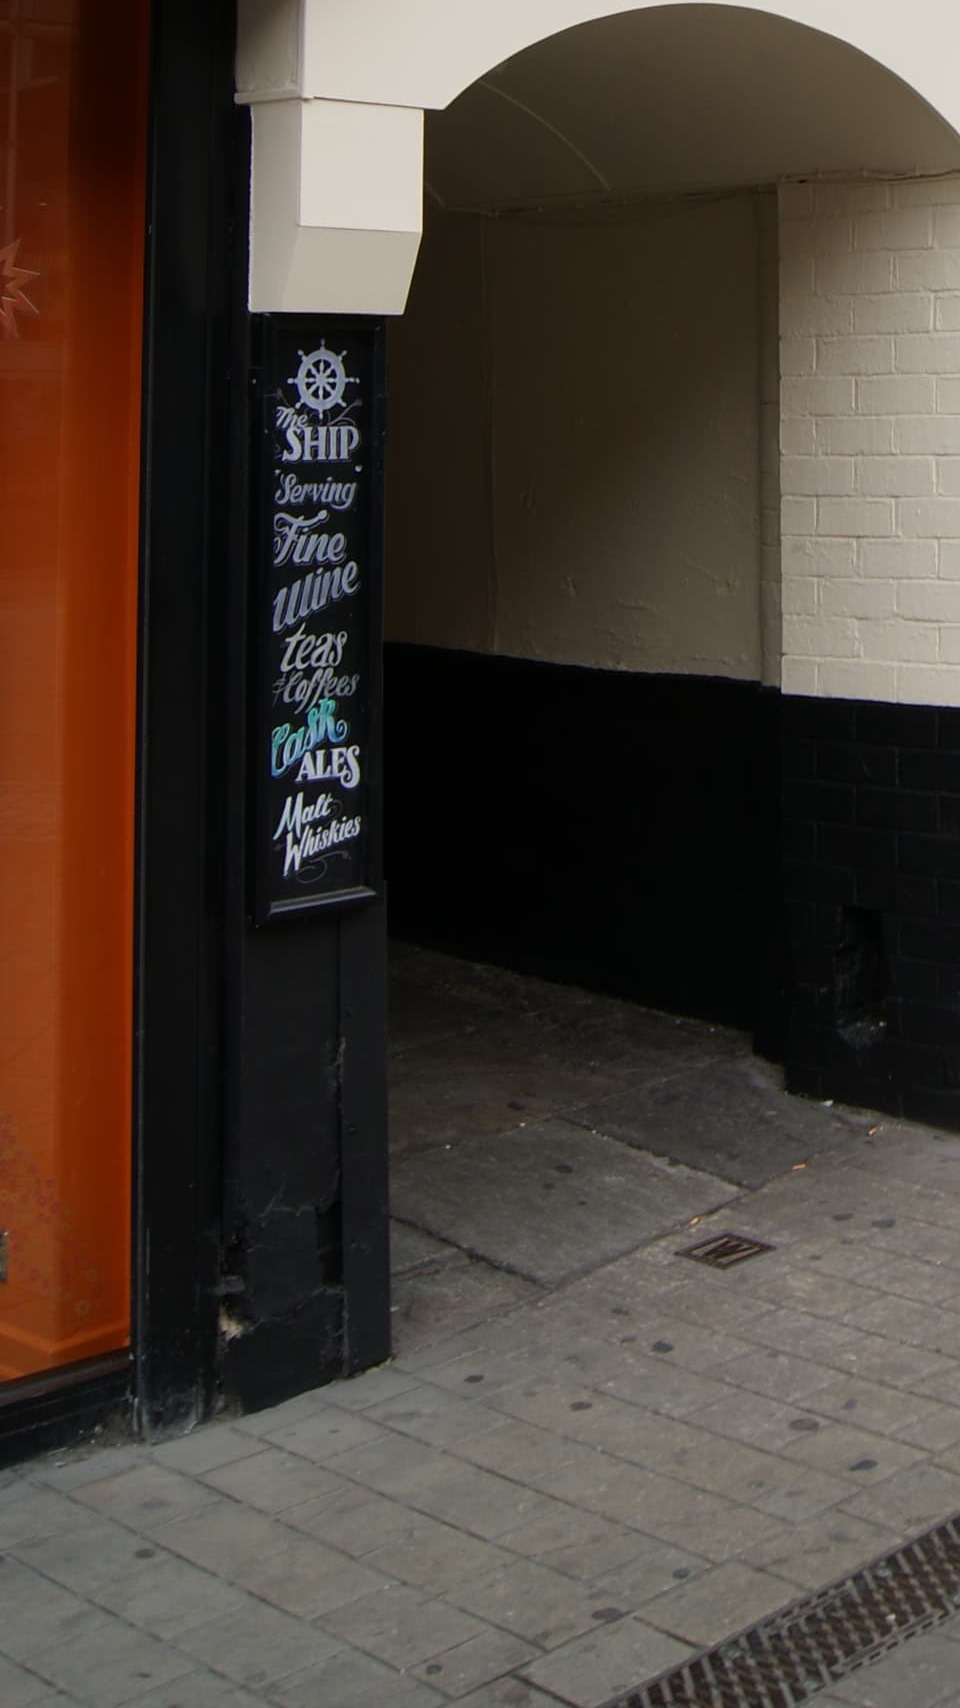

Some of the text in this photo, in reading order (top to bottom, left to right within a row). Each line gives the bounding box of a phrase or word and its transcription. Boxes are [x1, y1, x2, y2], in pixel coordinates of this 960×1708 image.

[275, 406, 309, 430] The
[281, 425, 361, 463] SHIP
[274, 472, 357, 510] Serving
[273, 509, 346, 566] Fine
[272, 560, 361, 633] Wine
[280, 622, 349, 673] teas
[283, 667, 360, 715] Coffees
[295, 744, 361, 789] ALES
[273, 792, 333, 841] Malt
[283, 815, 362, 877] Whiskies
